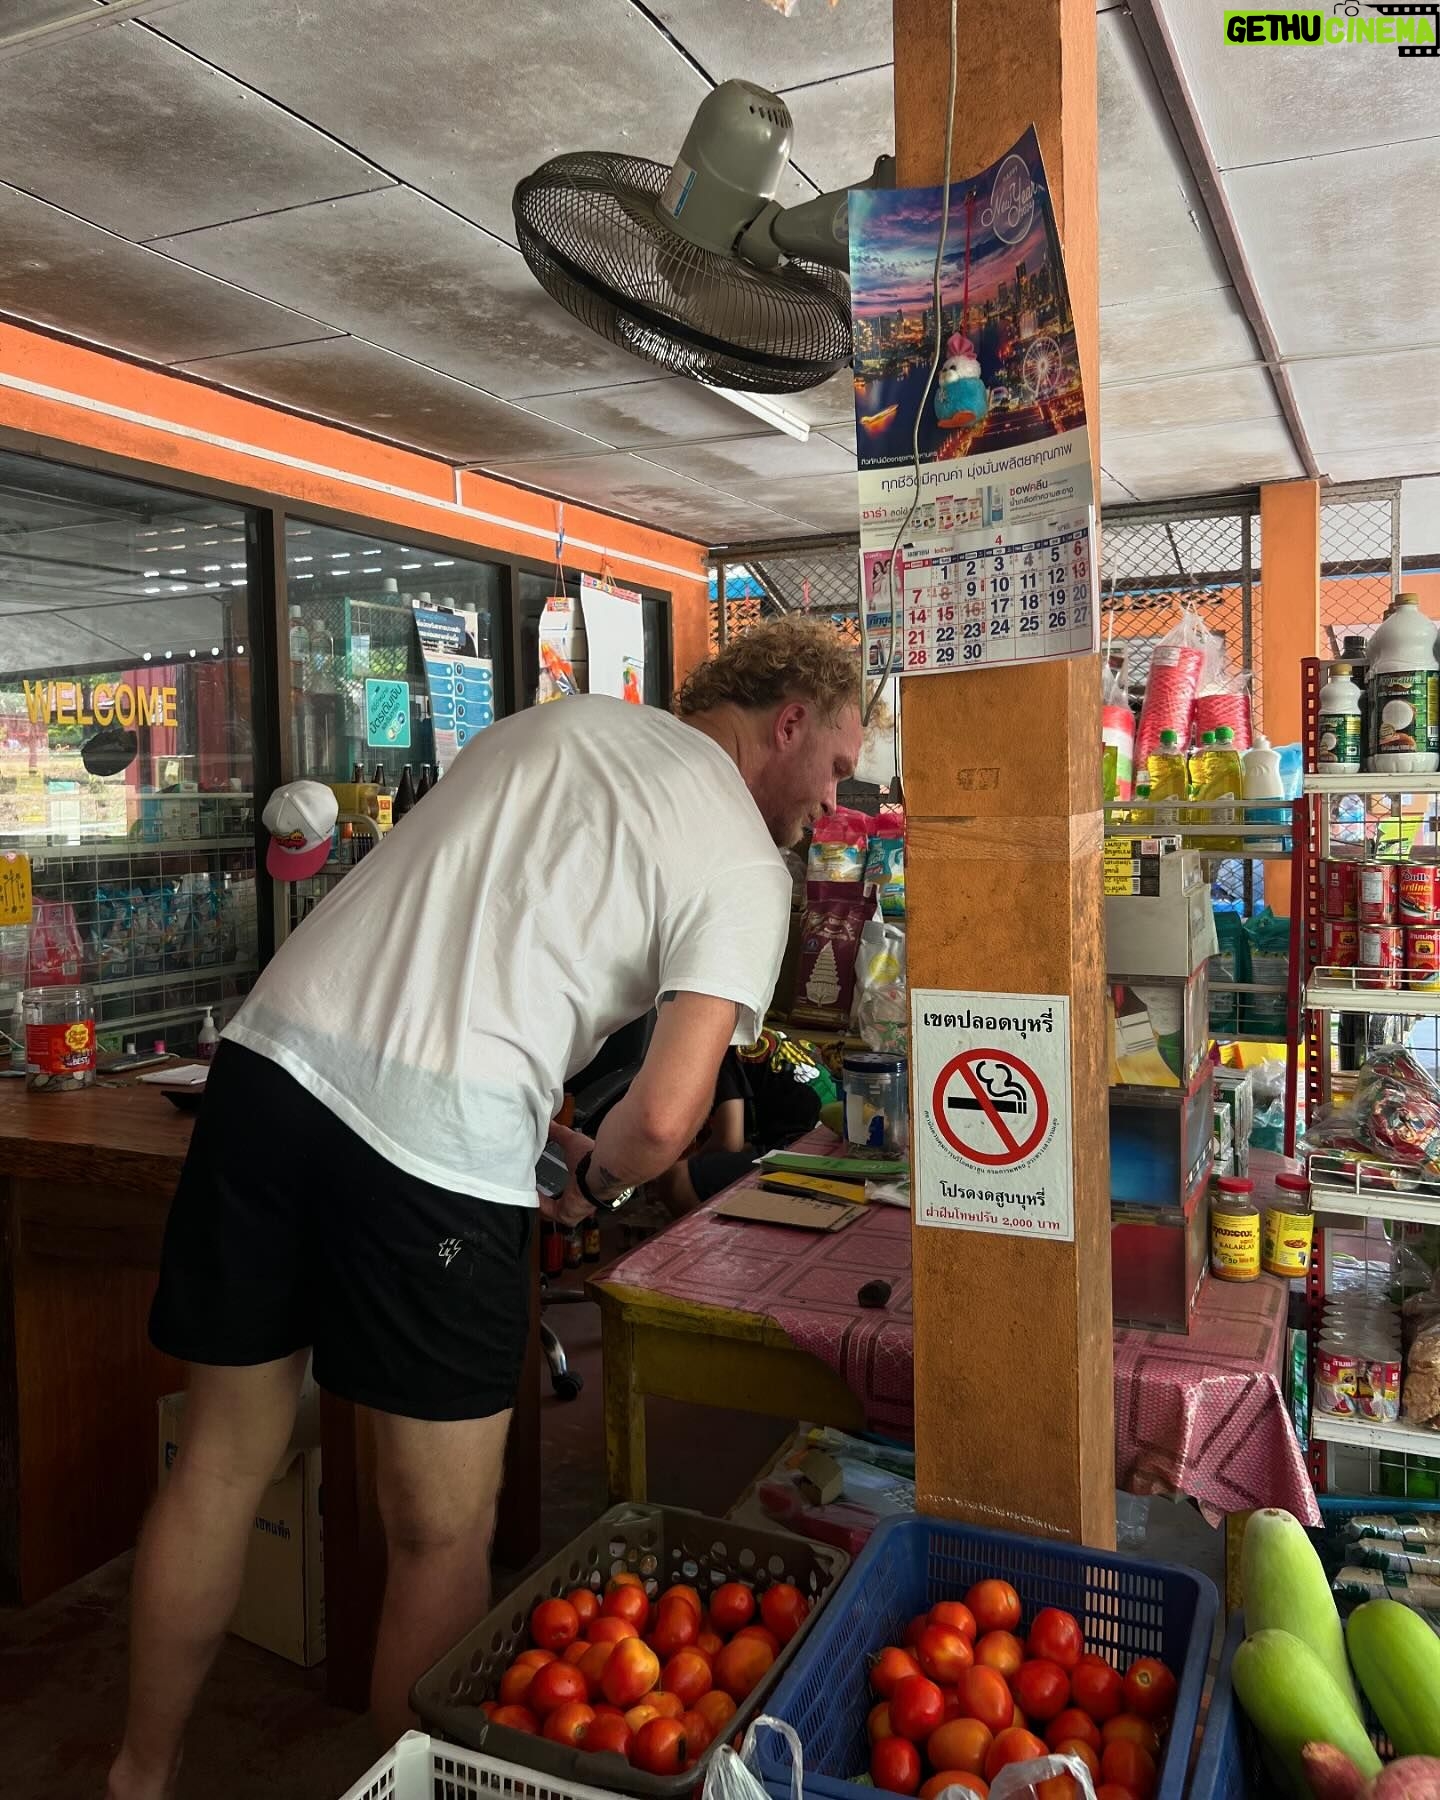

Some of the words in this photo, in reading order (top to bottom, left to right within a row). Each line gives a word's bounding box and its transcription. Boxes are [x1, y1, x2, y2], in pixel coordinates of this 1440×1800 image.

[995, 535, 1002, 545] 4
[941, 566, 948, 580] 1
[966, 561, 976, 576] 2
[994, 557, 1004, 571] 3
[1051, 547, 1060, 562] 5
[1073, 541, 1082, 556] 6
[912, 589, 922, 604] 7
[967, 582, 976, 596] 9
[990, 577, 1010, 593] 10
[1020, 573, 1036, 589] 11
[1048, 568, 1065, 585] 12
[1072, 562, 1086, 579] 13
[908, 609, 927, 624] 14
[937, 606, 954, 621] 15
[990, 598, 1010, 614] 17
[1020, 594, 1039, 611] 18
[1048, 590, 1066, 606] 19
[1072, 584, 1087, 602] 20
[908, 630, 925, 645] 21
[936, 627, 955, 643] 22
[963, 623, 981, 639] 23
[990, 619, 1010, 636] 24
[1020, 616, 1039, 632] 25
[1048, 611, 1067, 629] 26
[1073, 606, 1088, 624] 27
[908, 650, 927, 665] 28
[936, 647, 955, 663] 29
[963, 644, 981, 660] 30
[23, 680, 178, 727] WELCOME
[923, 1008, 1053, 1040] เขตปลอดบุหรี่
[939, 1180, 1046, 1209] โปรดงดสูบบุหรี่
[925, 1202, 998, 1225] ฝ่าฝืนโทษปรับ
[1002, 1216, 1033, 1229] 2,000
[1038, 1218, 1060, 1231] บาท
